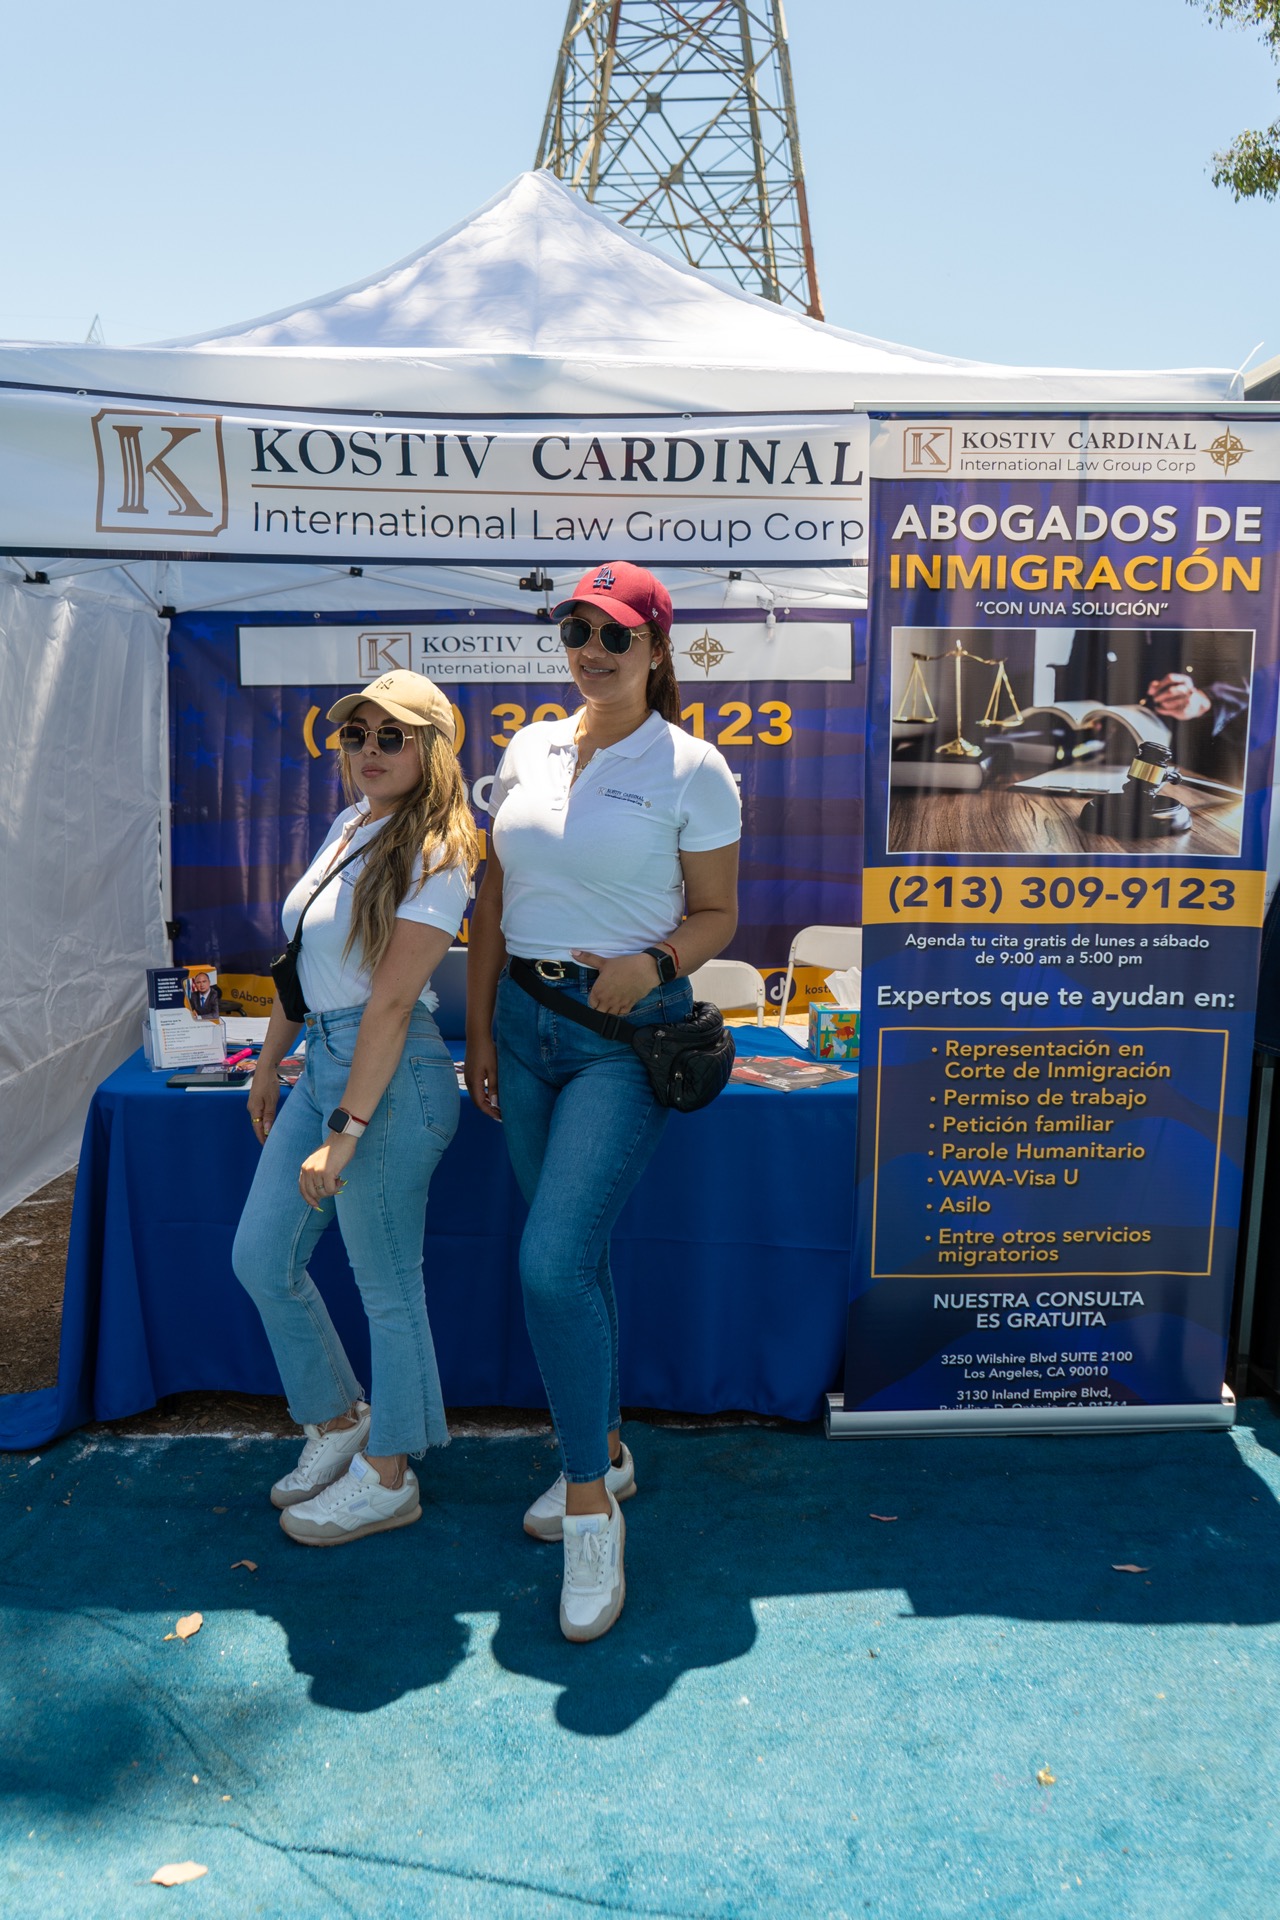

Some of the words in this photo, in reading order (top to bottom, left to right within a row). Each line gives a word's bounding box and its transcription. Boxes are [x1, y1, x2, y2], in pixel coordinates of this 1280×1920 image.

[911, 432, 948, 466] K
[961, 431, 1056, 450] KOSTIV
[1068, 431, 1197, 451] CARDINAL
[246, 427, 498, 479] KOSTIV
[532, 435, 864, 486] CARDINAL
[960, 458, 1062, 472] International
[1067, 458, 1099, 472] Law
[1103, 458, 1153, 474] Group
[1156, 459, 1196, 474] Corp
[112, 425, 214, 518] K
[253, 501, 516, 541] International
[533, 509, 614, 541] Law
[625, 511, 752, 548] Group
[764, 513, 864, 547] Corp
[891, 504, 1178, 543] ABOGADOS
[1196, 506, 1263, 543] DE
[889, 548, 1262, 592] INMIGRACIÓN
[1029, 601, 1067, 616] UNA
[421, 635, 523, 653] KOSTIV
[421, 661, 531, 675] International
[537, 662, 570, 675] Law
[889, 875, 1003, 914] (213)
[1020, 876, 1236, 912] 309-9123
[905, 934, 966, 949] Agenda
[970, 935, 986, 948] tu
[991, 934, 1019, 947] cita
[1023, 934, 1067, 950] gratis
[1071, 934, 1090, 948] de
[1094, 934, 1136, 948] lunes
[1140, 938, 1149, 948] a
[1152, 933, 1210, 949] sábado
[975, 951, 995, 965] de
[1000, 951, 1034, 965] 9:00
[1038, 955, 1062, 965] am
[1066, 955, 1075, 965] a
[1079, 951, 1113, 965] 5:00
[1118, 954, 1143, 967] pm
[877, 986, 992, 1011] Expertos
[1001, 989, 1049, 1011] que
[1057, 987, 1083, 1007] te
[1091, 984, 1185, 1011] ayudan
[1194, 991, 1236, 1008] en:
[945, 1040, 1111, 1061] Representación
[1118, 1044, 1144, 1057] en
[945, 1063, 1005, 1079] Corte
[1013, 1061, 1041, 1079] de
[1048, 1061, 1171, 1082] Inmigración
[944, 1089, 1030, 1106] Permiso
[1037, 1088, 1063, 1106] de
[1070, 1088, 1147, 1110] trabajo
[943, 1116, 1028, 1133] Petición
[1035, 1114, 1114, 1132] familiar
[942, 1143, 1009, 1160] Parole
[1016, 1142, 1146, 1159] Humanitario
[938, 1169, 1057, 1186] VAWA-Visa
[1063, 1169, 1079, 1185] U
[939, 1196, 991, 1213] Asilo
[938, 1228, 995, 1245] Entre
[1002, 1230, 1056, 1244] otros
[1062, 1226, 1152, 1243] servicios
[938, 1246, 1060, 1267] migratorios
[933, 1292, 1030, 1310] NUESTRA
[1036, 1290, 1145, 1308] CONSULTA
[976, 1313, 1001, 1329] ES
[1007, 1311, 1107, 1329] GRATUITA
[941, 1354, 973, 1365] 3250
[976, 1353, 1026, 1364] Wilshire
[1030, 1352, 1057, 1363] Blvd
[1060, 1351, 1098, 1363] SUITE
[1101, 1351, 1133, 1362] 2100
[964, 1368, 986, 1379] Los
[989, 1366, 1043, 1381] Angeles,
[1046, 1367, 1066, 1377] CA
[1069, 1366, 1109, 1377] 90010
[956, 1390, 989, 1400] 3130
[992, 1388, 1030, 1400] Inland
[1033, 1388, 1078, 1401] Empire
[1081, 1387, 1112, 1399] Blvd,
